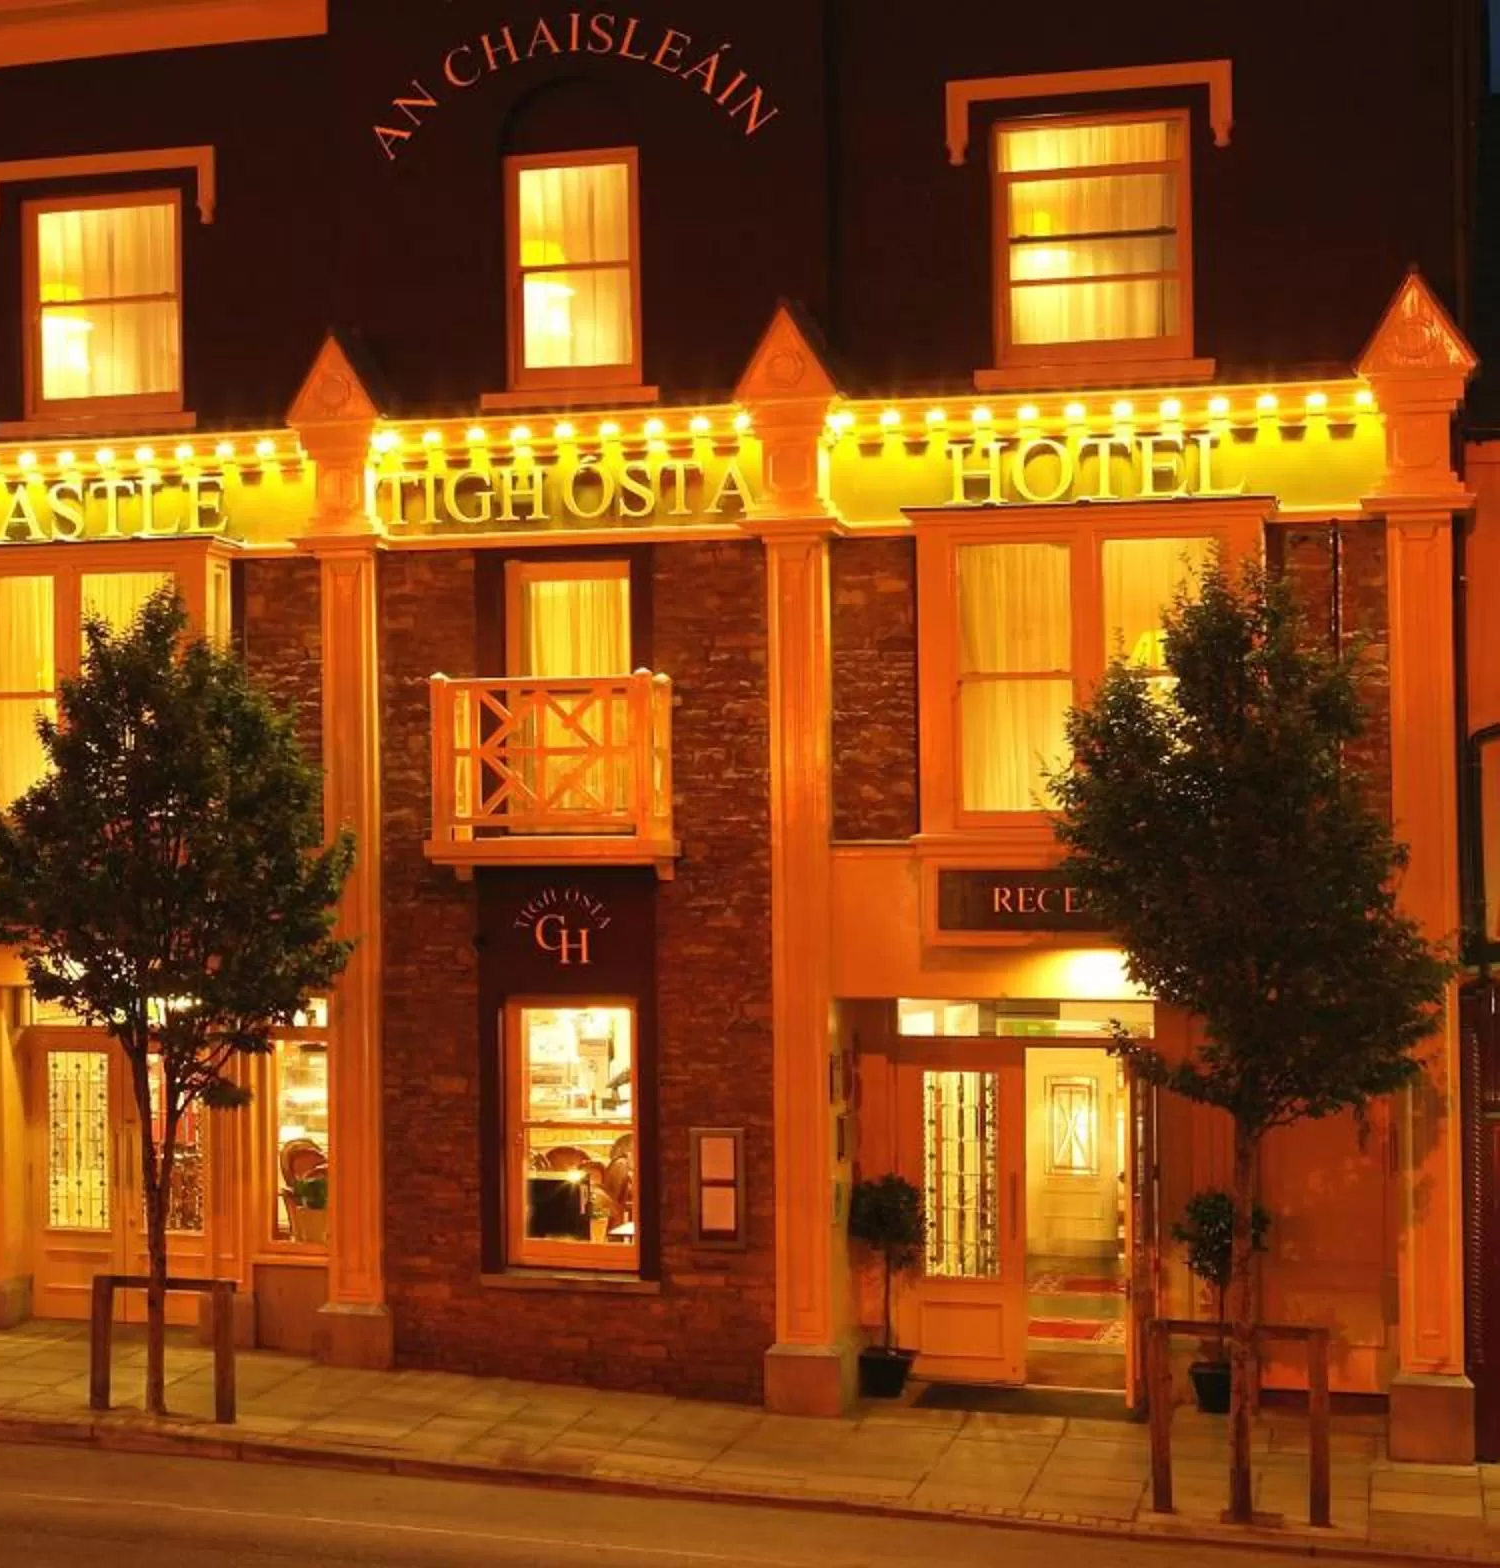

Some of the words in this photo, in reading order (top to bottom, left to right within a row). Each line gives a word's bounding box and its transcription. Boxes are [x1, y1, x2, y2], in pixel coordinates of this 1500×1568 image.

[373, 79, 438, 160] AN
[443, 12, 779, 136] CHAISLEÁIN
[377, 464, 550, 526] TIGH
[563, 455, 758, 518] ÓSTA
[947, 434, 1246, 504] HOTEL
[993, 887, 1094, 913] RECE
